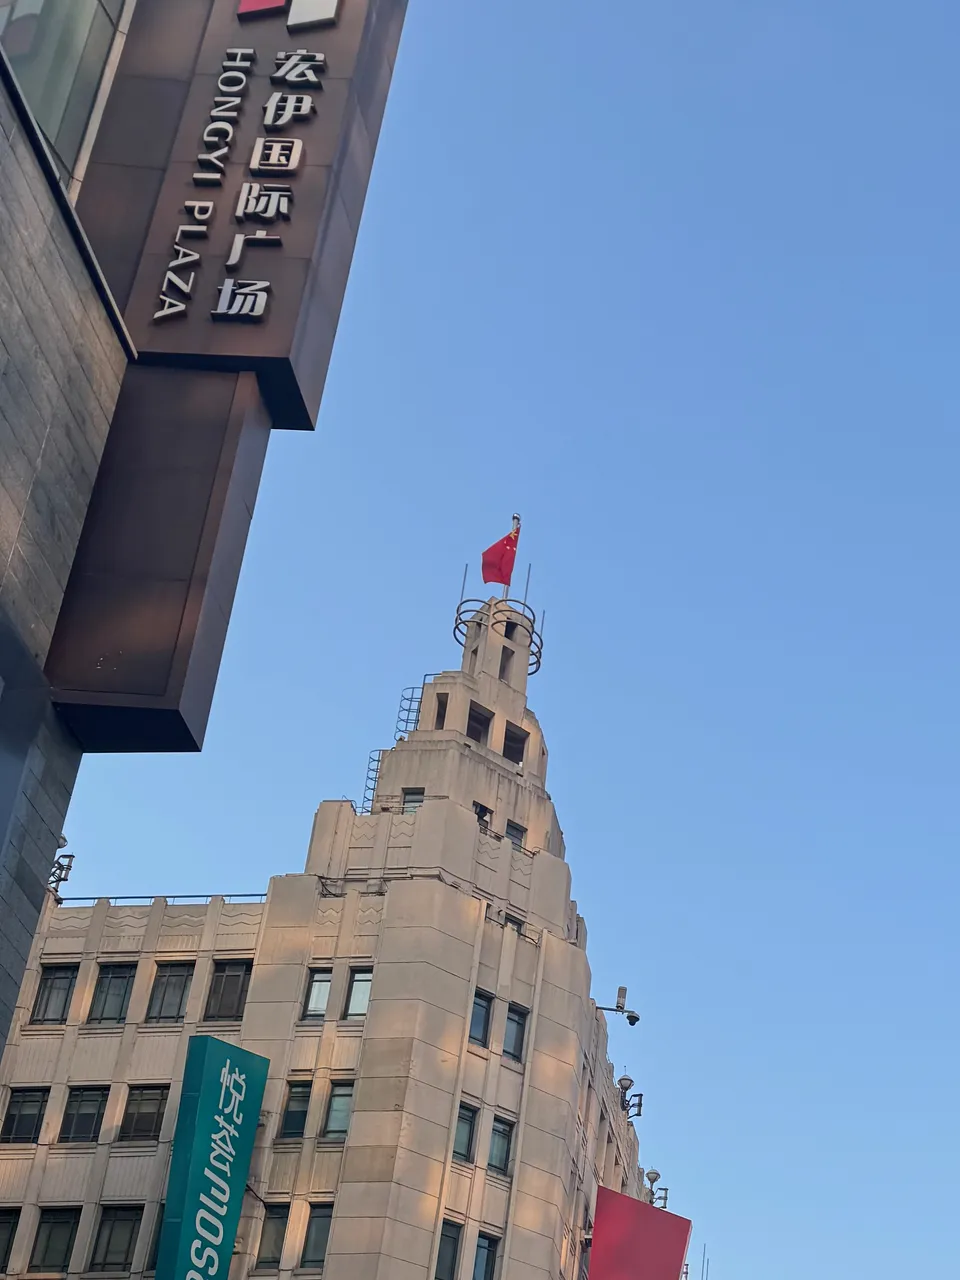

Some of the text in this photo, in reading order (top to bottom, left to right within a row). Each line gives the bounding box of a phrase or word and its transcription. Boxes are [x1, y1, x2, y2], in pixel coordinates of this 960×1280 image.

[153, 48, 256, 319] HONGYI PLAZA
[211, 49, 327, 322] 宏伊国际广场
